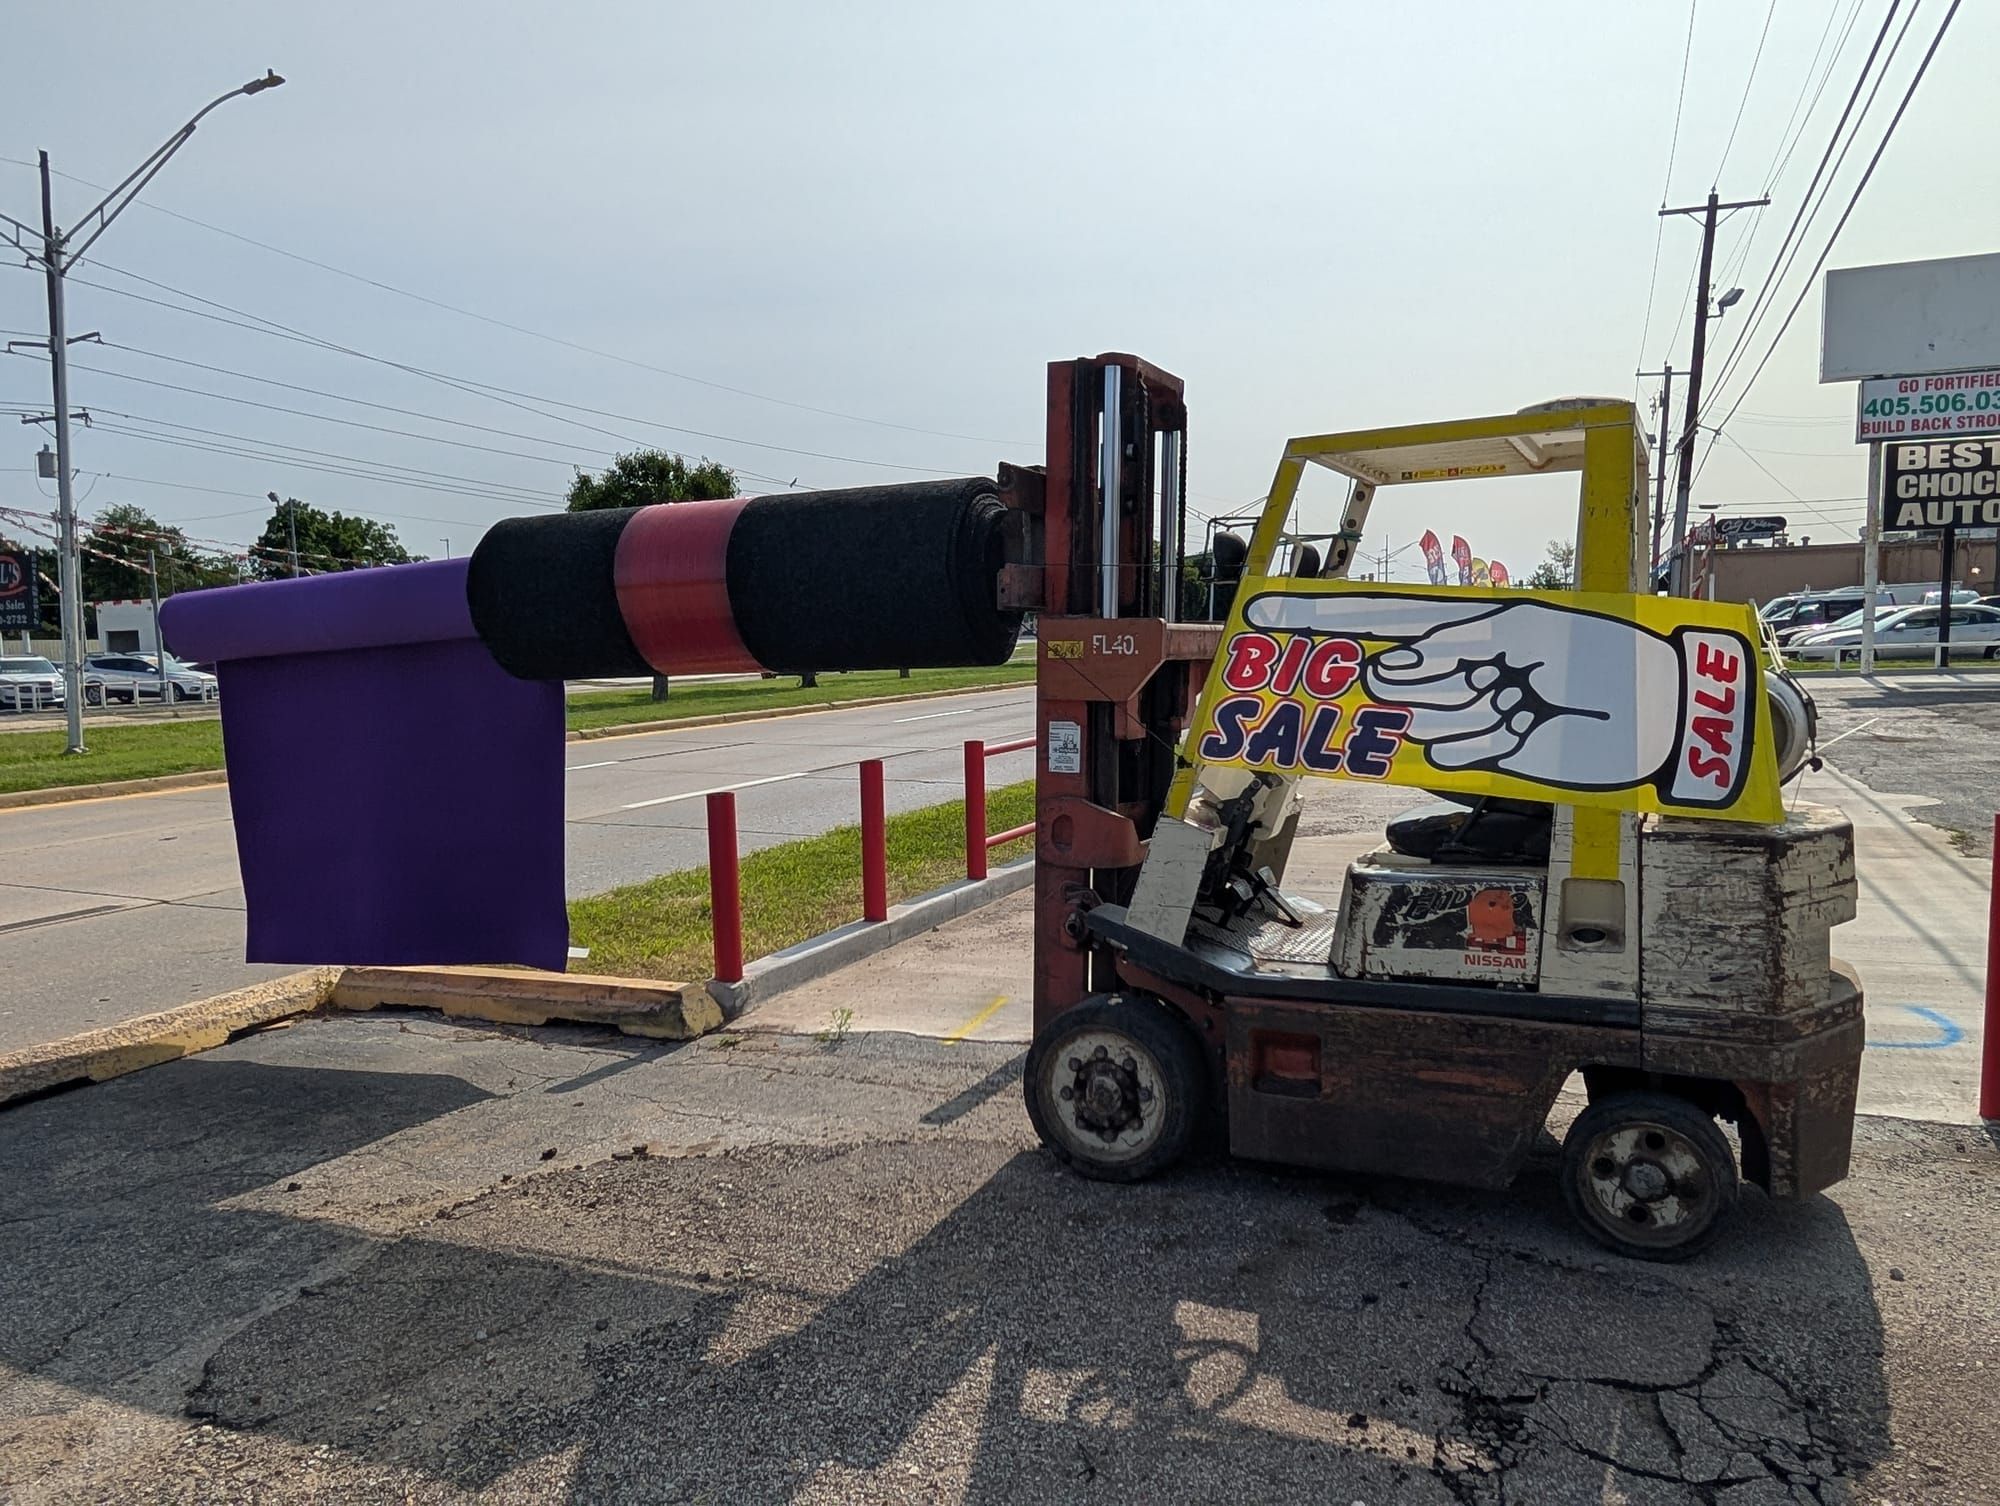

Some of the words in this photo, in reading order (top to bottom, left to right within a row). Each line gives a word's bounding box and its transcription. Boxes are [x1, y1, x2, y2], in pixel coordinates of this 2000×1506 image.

[1899, 379, 1919, 393] GO
[1862, 420, 1905, 434] BUILD
[1911, 417, 1952, 431] BACK
[1957, 414, 2000, 429] STRO
[1897, 441, 2000, 470] BEST
[1897, 470, 2000, 498] CHOIC
[1896, 499, 2000, 526] AUTO
[1225, 633, 1363, 699] BIG
[1689, 641, 1739, 789] SALE
[1201, 696, 1413, 779] SALE
[1464, 954, 1527, 969] NISSAN
